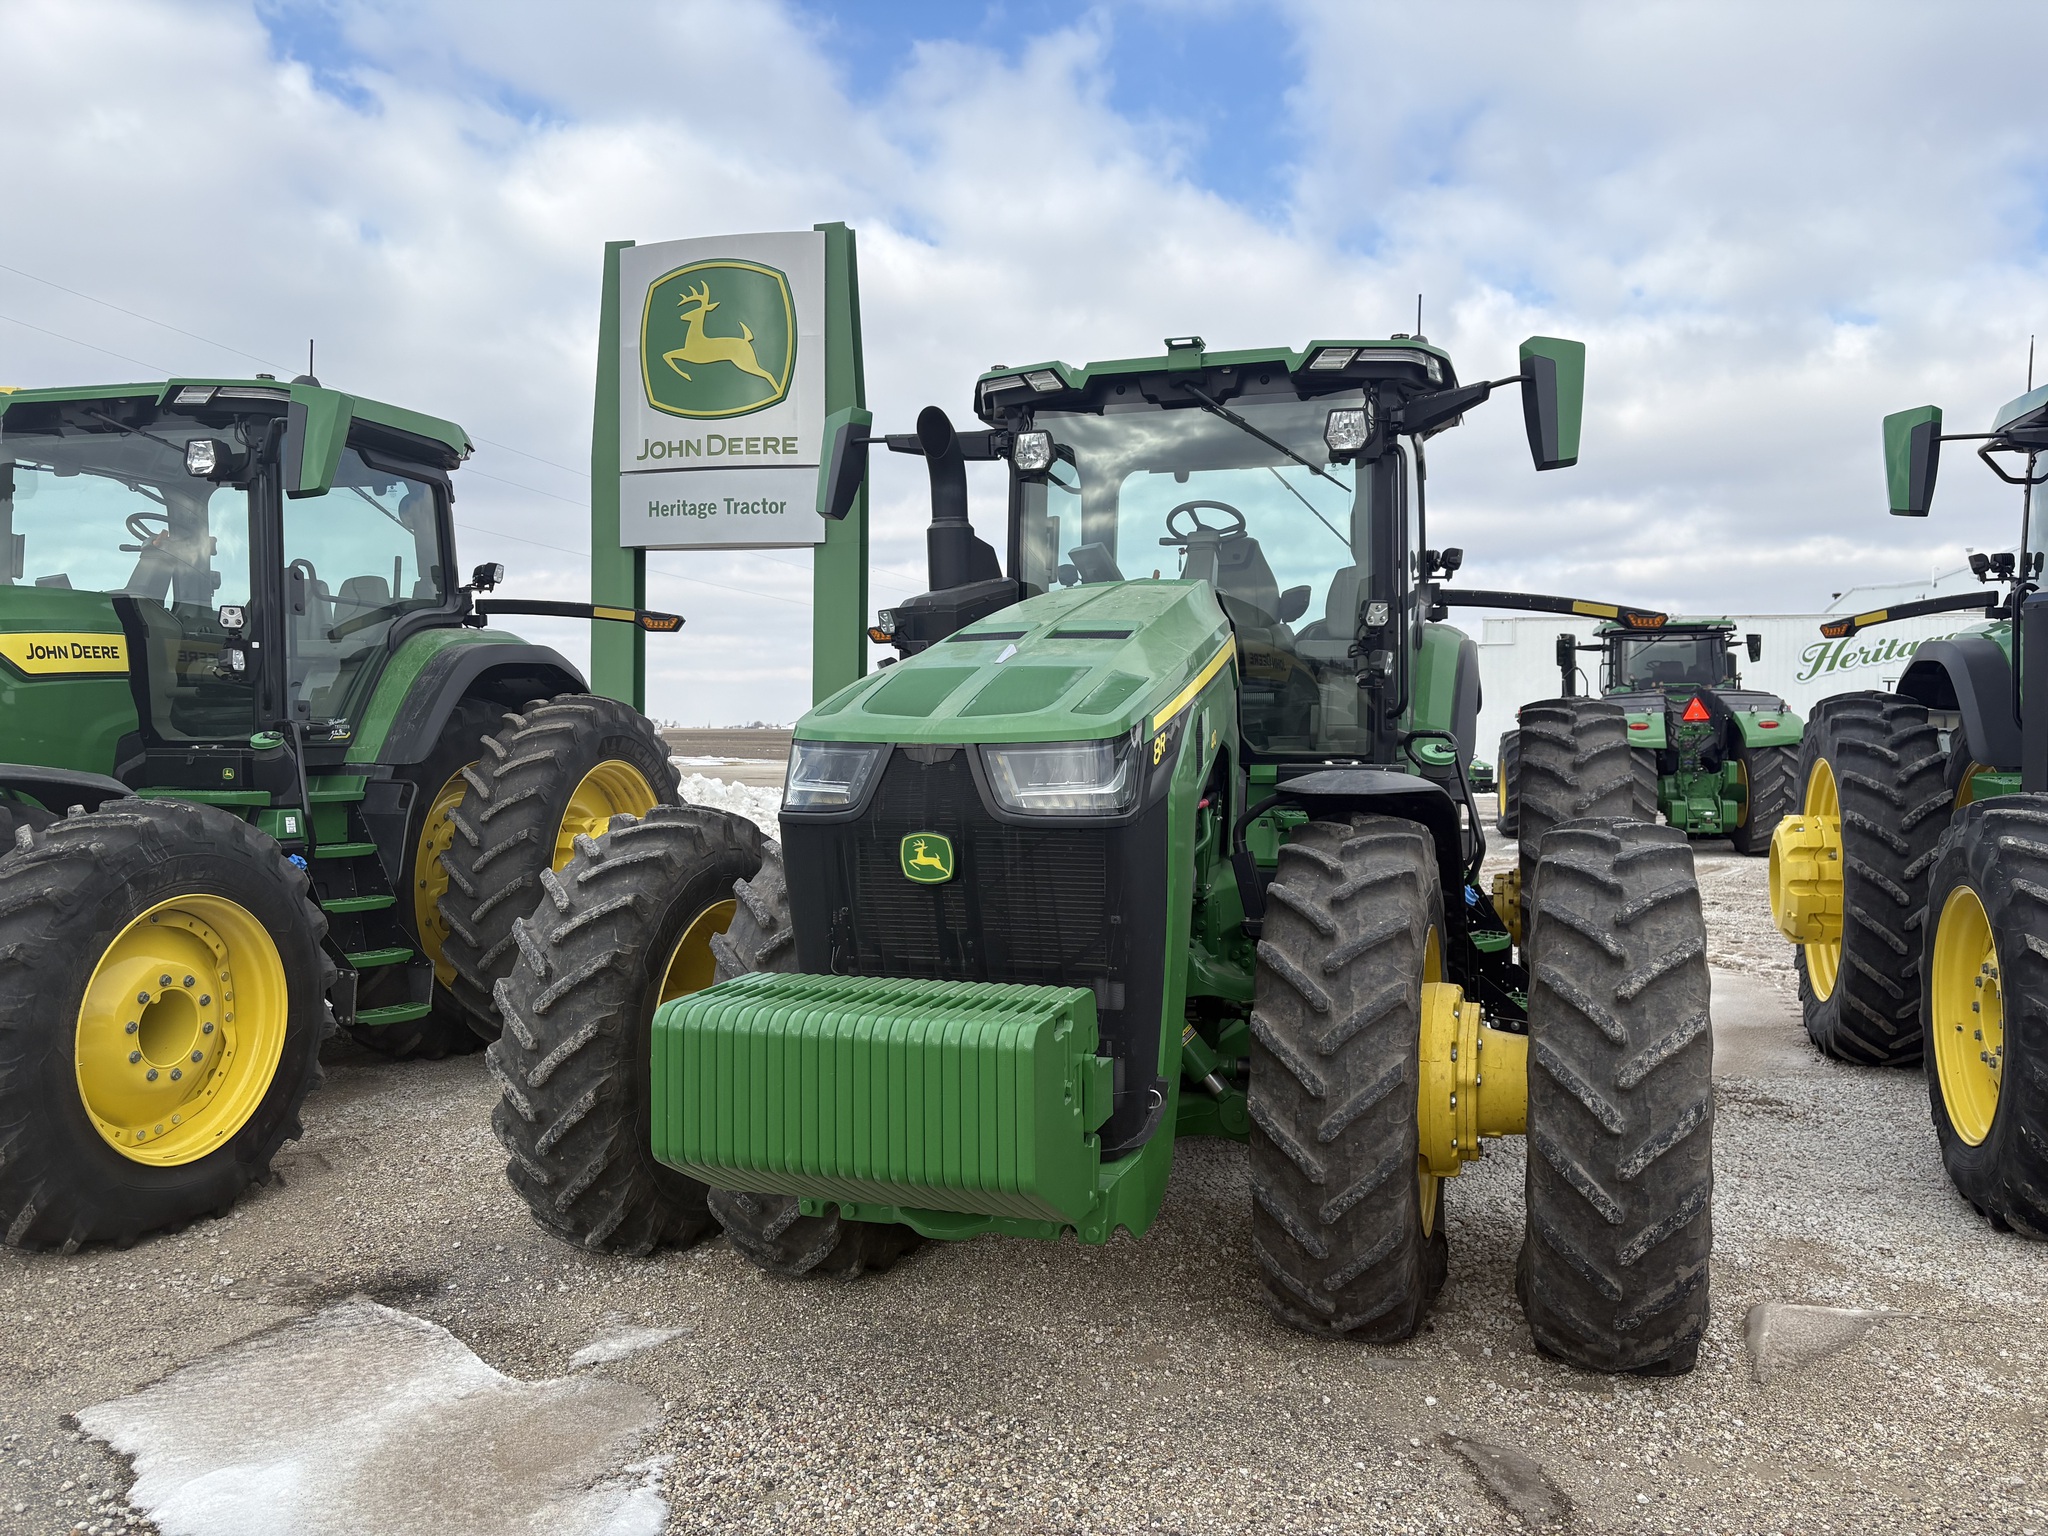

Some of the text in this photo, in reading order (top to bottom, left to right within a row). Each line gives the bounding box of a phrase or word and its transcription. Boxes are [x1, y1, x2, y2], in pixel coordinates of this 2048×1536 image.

[636, 434, 798, 461] JOHN DEERE
[648, 497, 787, 519] Heritage Tractor
[26, 642, 120, 660] JOHN DEERE
[1153, 731, 1166, 766] 8R
